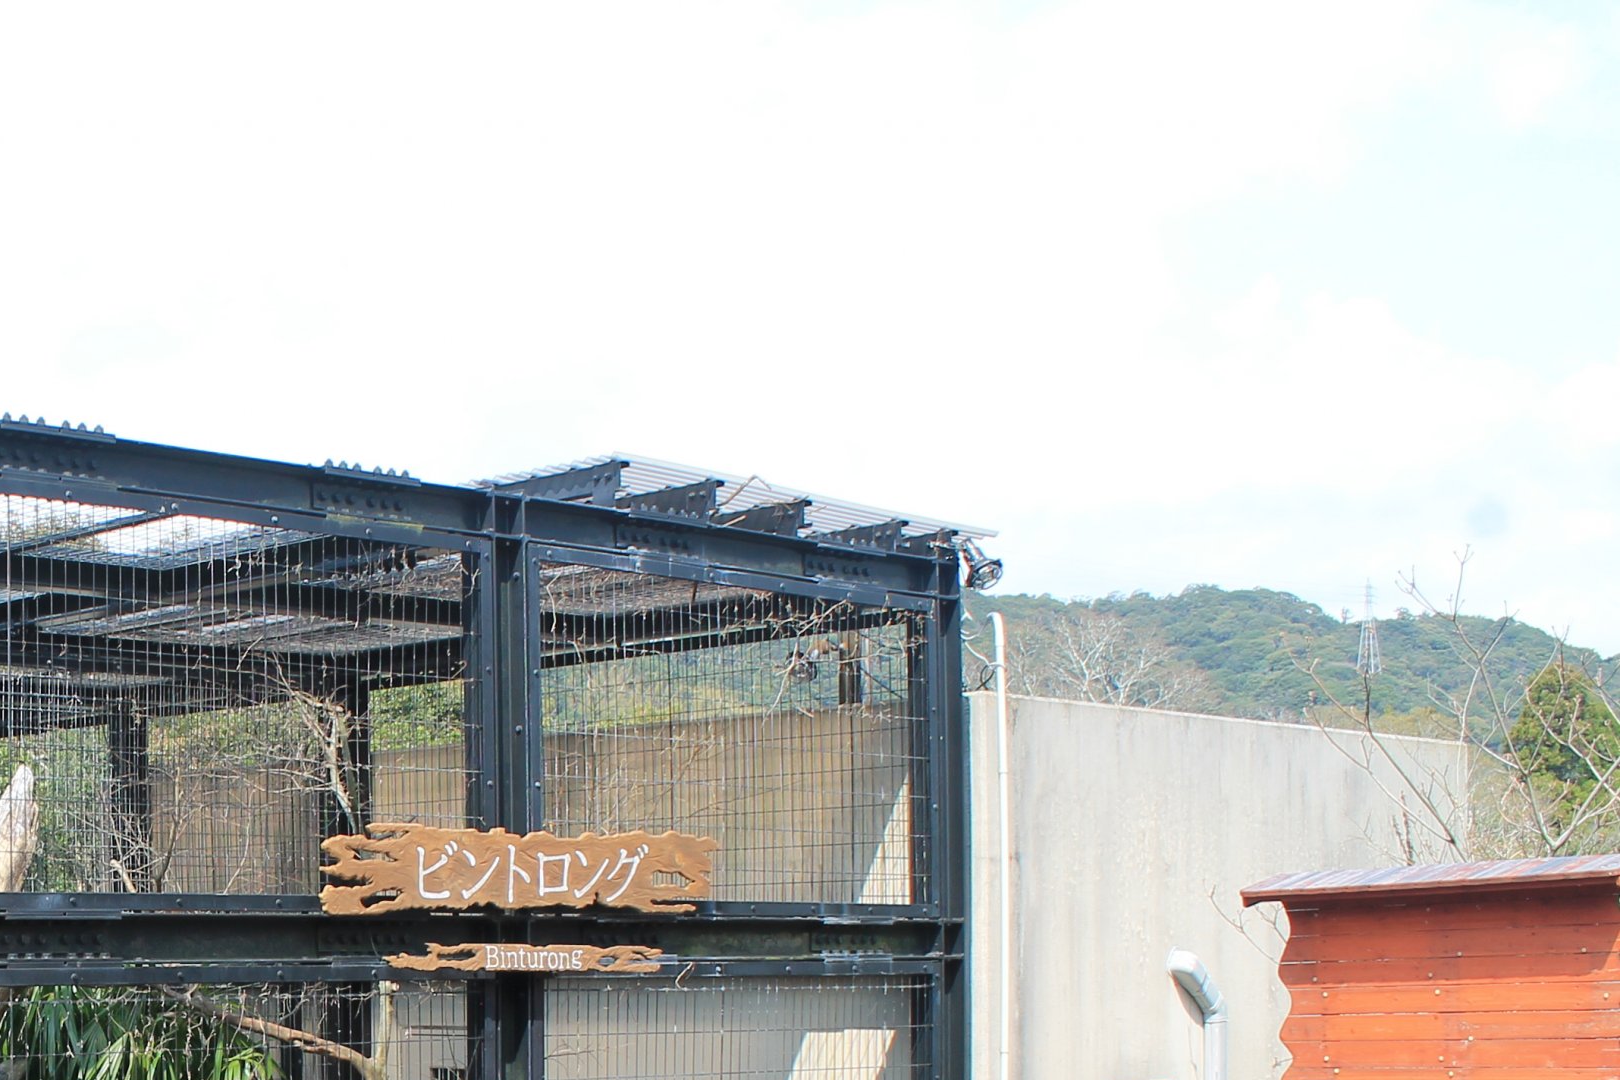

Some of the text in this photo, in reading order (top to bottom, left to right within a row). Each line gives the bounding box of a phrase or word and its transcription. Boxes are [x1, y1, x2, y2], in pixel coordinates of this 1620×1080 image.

[417, 840, 650, 903] ビントロング
[485, 945, 583, 969] Binturong
